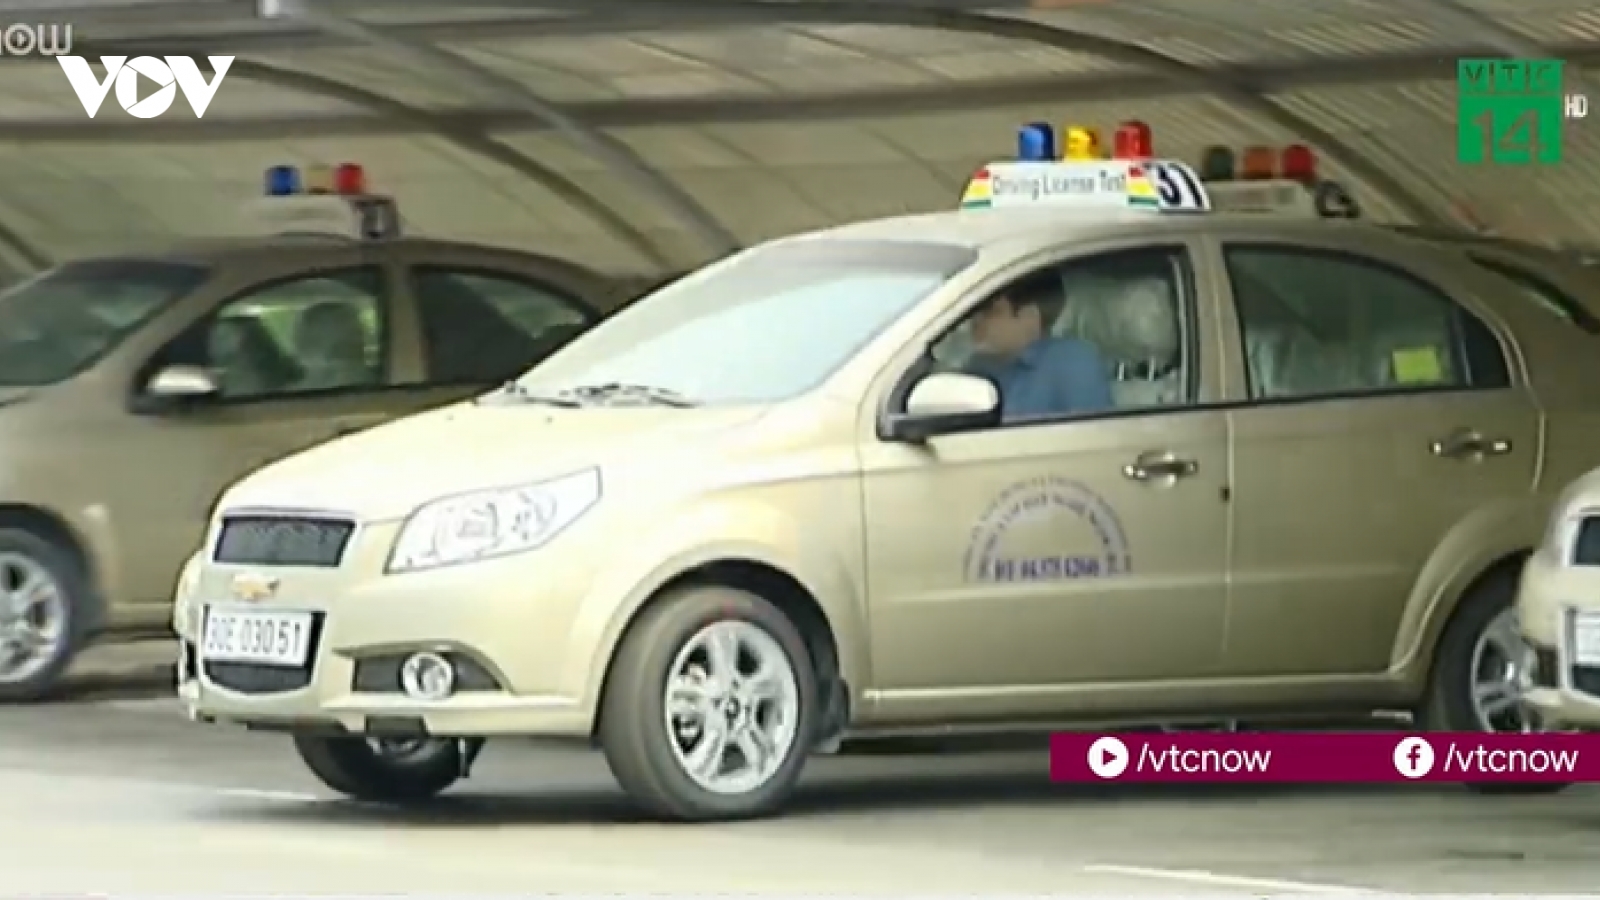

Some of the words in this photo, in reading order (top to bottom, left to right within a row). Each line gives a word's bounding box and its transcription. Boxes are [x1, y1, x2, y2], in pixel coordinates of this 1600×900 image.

[992, 174, 1039, 201] Driving
[1043, 173, 1094, 195] License
[1098, 170, 1127, 192] Test
